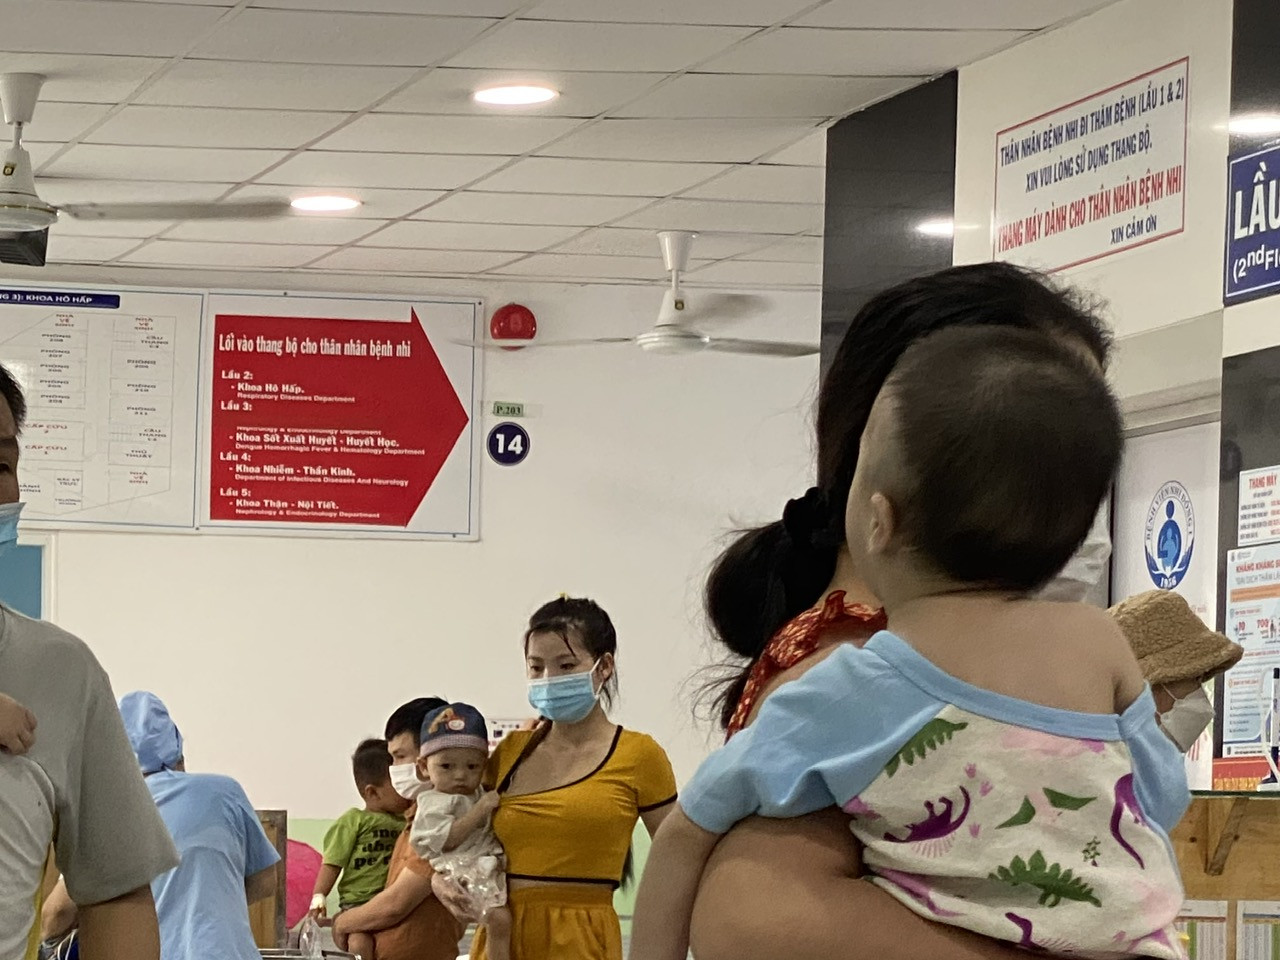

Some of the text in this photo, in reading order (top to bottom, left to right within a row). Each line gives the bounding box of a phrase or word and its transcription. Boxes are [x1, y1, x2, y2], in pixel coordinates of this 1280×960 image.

[1000, 138, 1020, 167] THÂN
[1021, 130, 1042, 158] NHÂN
[1043, 123, 1064, 152] BỆNH
[1065, 119, 1078, 143] NHI
[1114, 94, 1136, 126] BỆNH
[1160, 85, 1164, 106] 1
[1166, 82, 1174, 103] &
[1176, 77, 1184, 102] 2)
[1026, 172, 1038, 193] XIN
[1039, 167, 1052, 188] VUI
[1054, 156, 1074, 183] LÒNG
[1088, 145, 1109, 174] DỤNG
[1111, 135, 1136, 162] THANG
[1234, 162, 1280, 240] LẦU
[998, 165, 1182, 252] THANG MÁY DÀNH CHO THÂN NHÂN BỆNH NHI
[1111, 227, 1124, 245] XIN
[26, 294, 54, 304] KHOA
[236, 335, 254, 352] vào
[256, 336, 283, 357] thang
[286, 336, 298, 358] bộ
[300, 338, 318, 354] cho
[320, 338, 342, 356] thân
[344, 339, 367, 356] nhân
[370, 340, 393, 360] bệnh
[396, 340, 412, 358] nhi
[244, 371, 254, 380] 2:
[237, 382, 262, 392] Khoa
[242, 402, 252, 412] 3:
[236, 433, 261, 444] Khoa
[496, 433, 524, 454] 14
[240, 452, 252, 462] 4:
[236, 464, 260, 474] Khoa
[330, 467, 356, 477] Kinh.
[240, 488, 252, 498] 5:
[236, 499, 260, 508] Khoa
[263, 500, 288, 510] Thận
[297, 500, 314, 511] Nội
